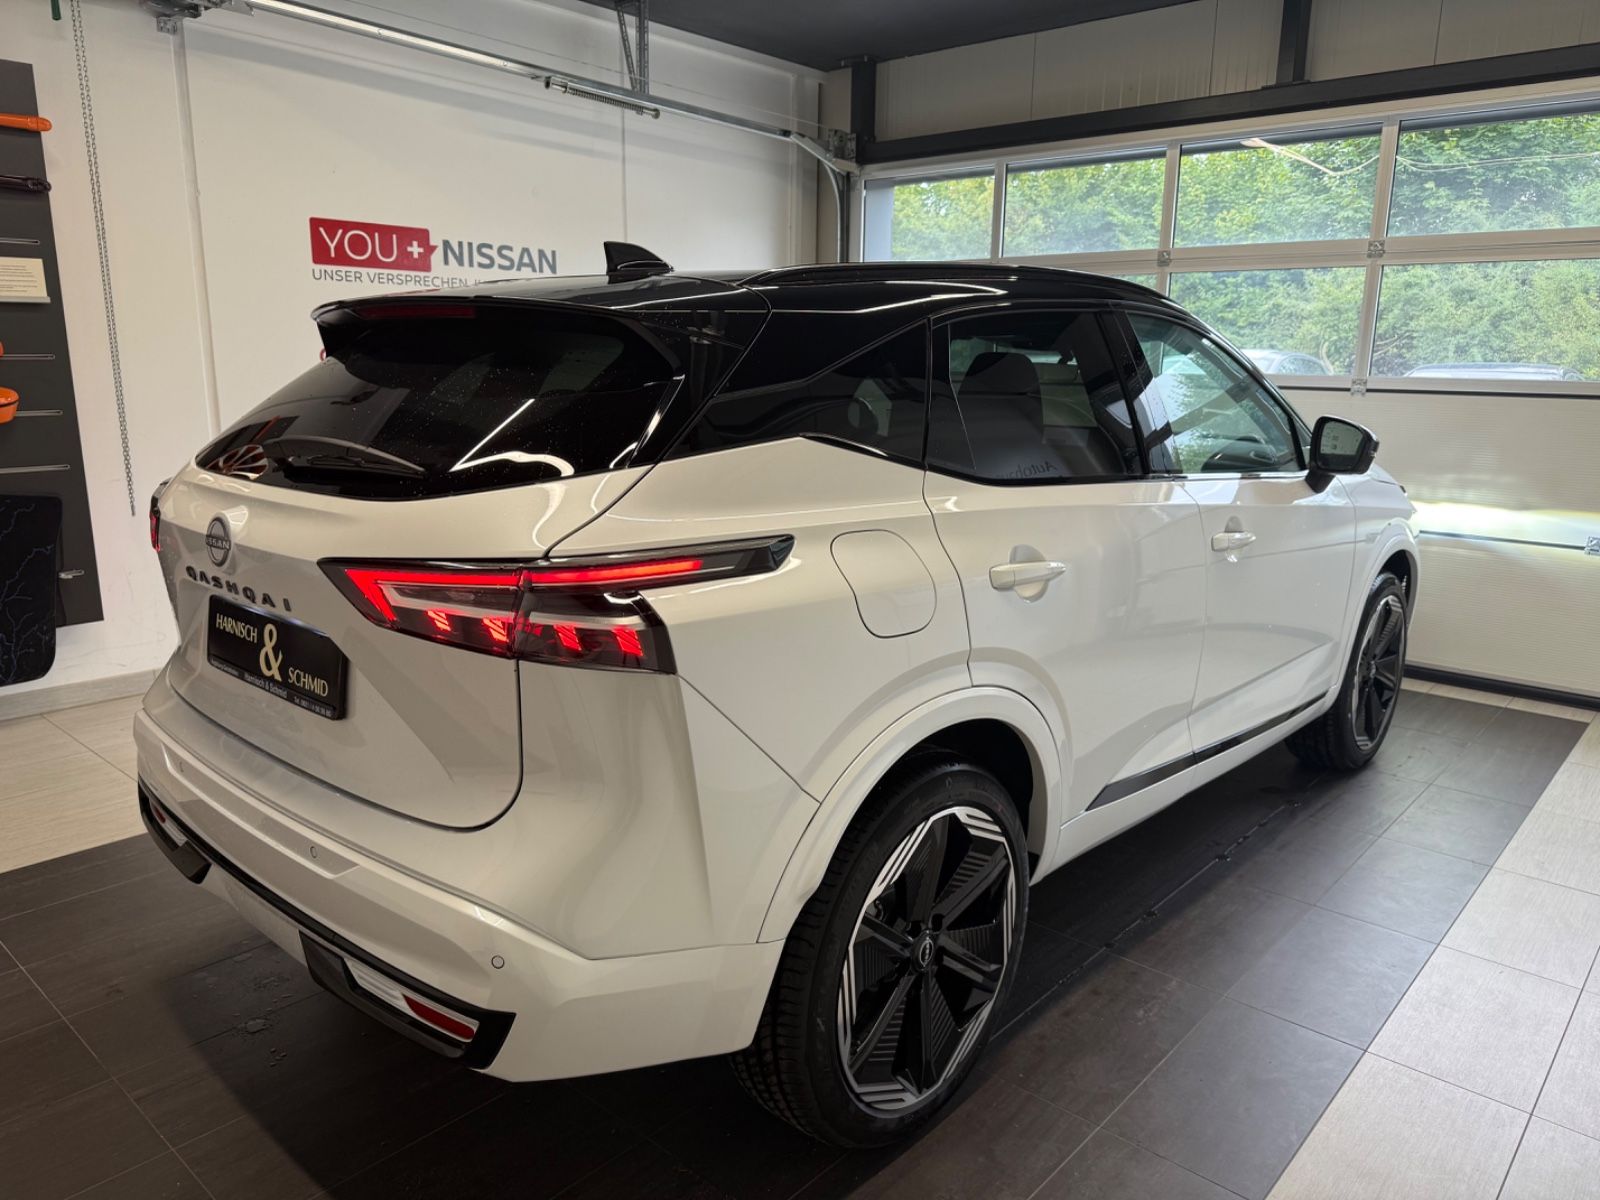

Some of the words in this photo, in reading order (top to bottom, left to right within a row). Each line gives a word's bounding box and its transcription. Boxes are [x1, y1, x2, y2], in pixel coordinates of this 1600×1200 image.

[318, 226, 398, 263] YOU
[441, 238, 558, 275] NISSAN
[312, 268, 363, 283] UNSER
[186, 565, 292, 612] QASHQAI
[215, 612, 258, 644] HARNISCH
[259, 623, 283, 682] &
[287, 667, 329, 698] SCHMID
